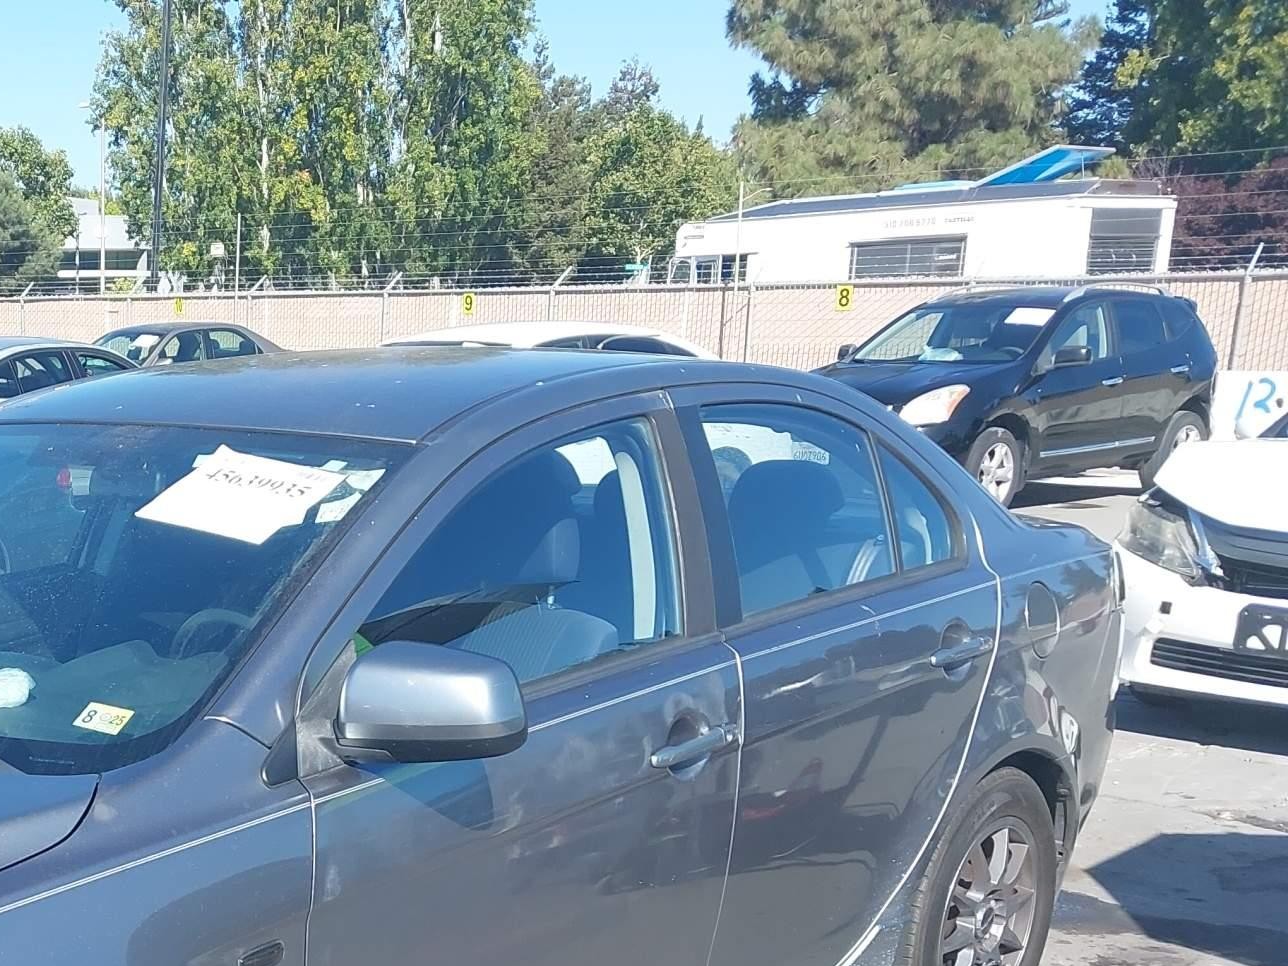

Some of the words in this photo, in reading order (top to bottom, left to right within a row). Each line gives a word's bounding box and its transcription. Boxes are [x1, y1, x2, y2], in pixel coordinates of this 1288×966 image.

[465, 295, 473, 311] 9
[839, 288, 850, 307] 8
[81, 709, 98, 723] 8
[108, 714, 127, 726] 25
